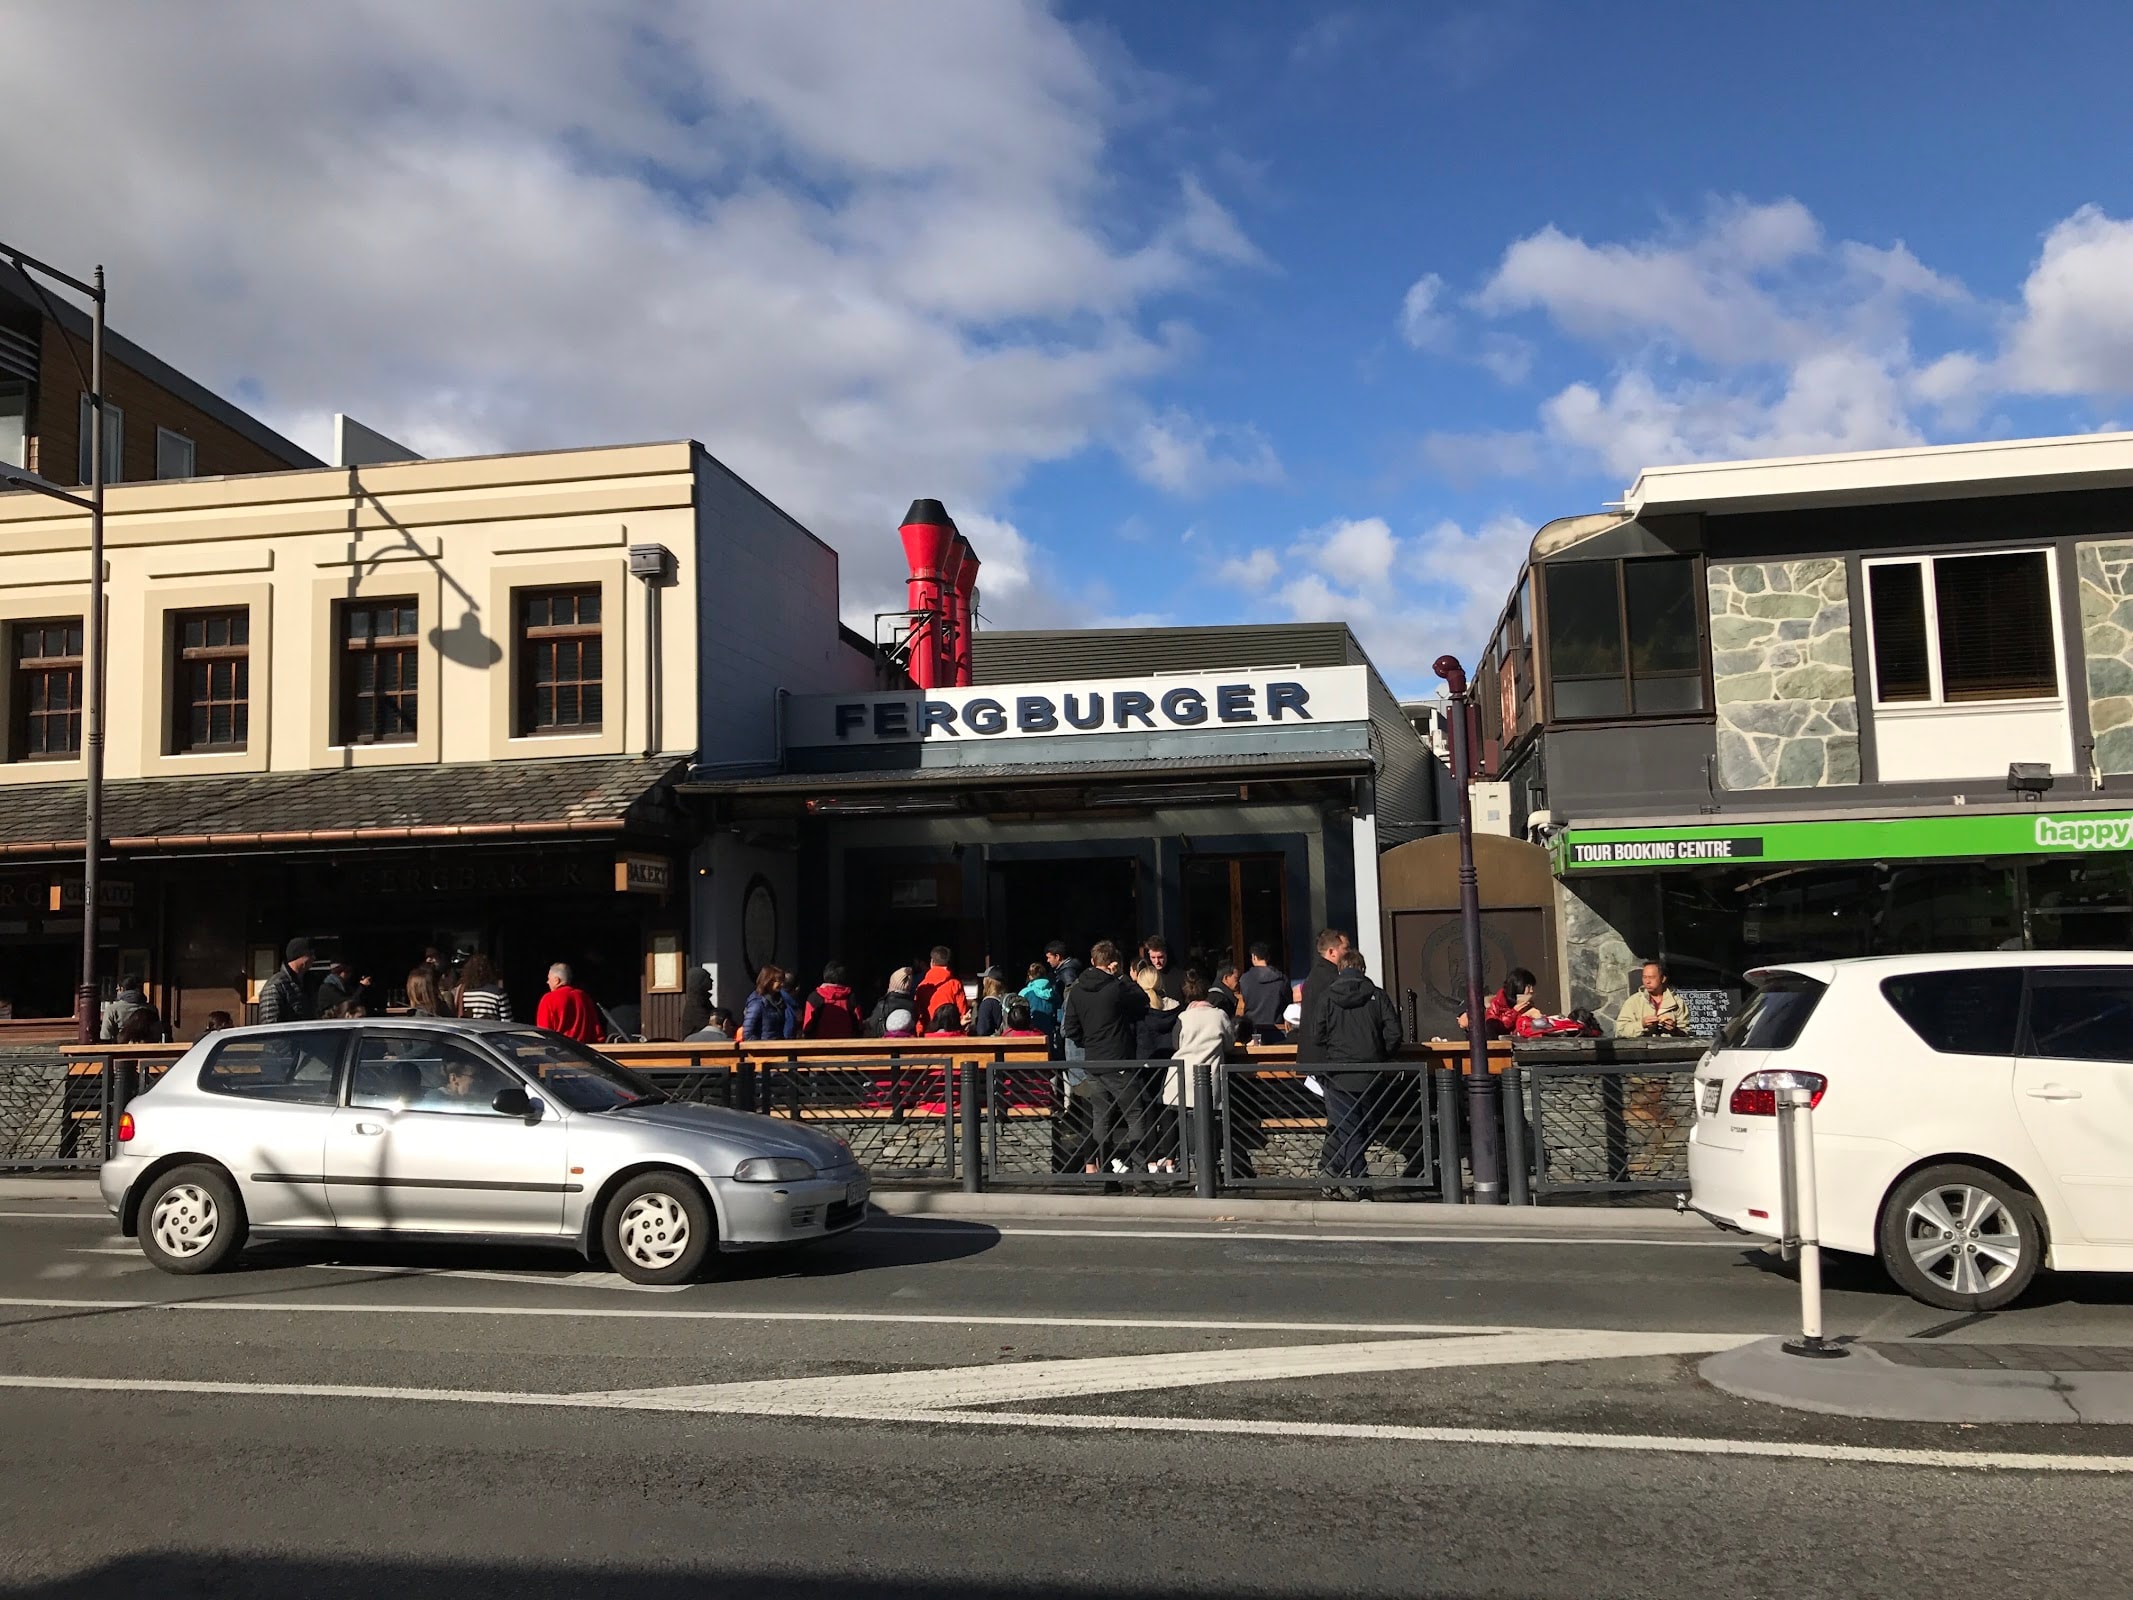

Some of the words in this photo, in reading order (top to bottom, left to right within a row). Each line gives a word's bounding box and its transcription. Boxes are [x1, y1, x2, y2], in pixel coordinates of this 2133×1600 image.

[835, 681, 1313, 737] FERGBURGER
[1575, 844, 1611, 861] TOUR
[1614, 842, 1675, 860] BOOKING
[1677, 840, 1732, 858] CENTRE
